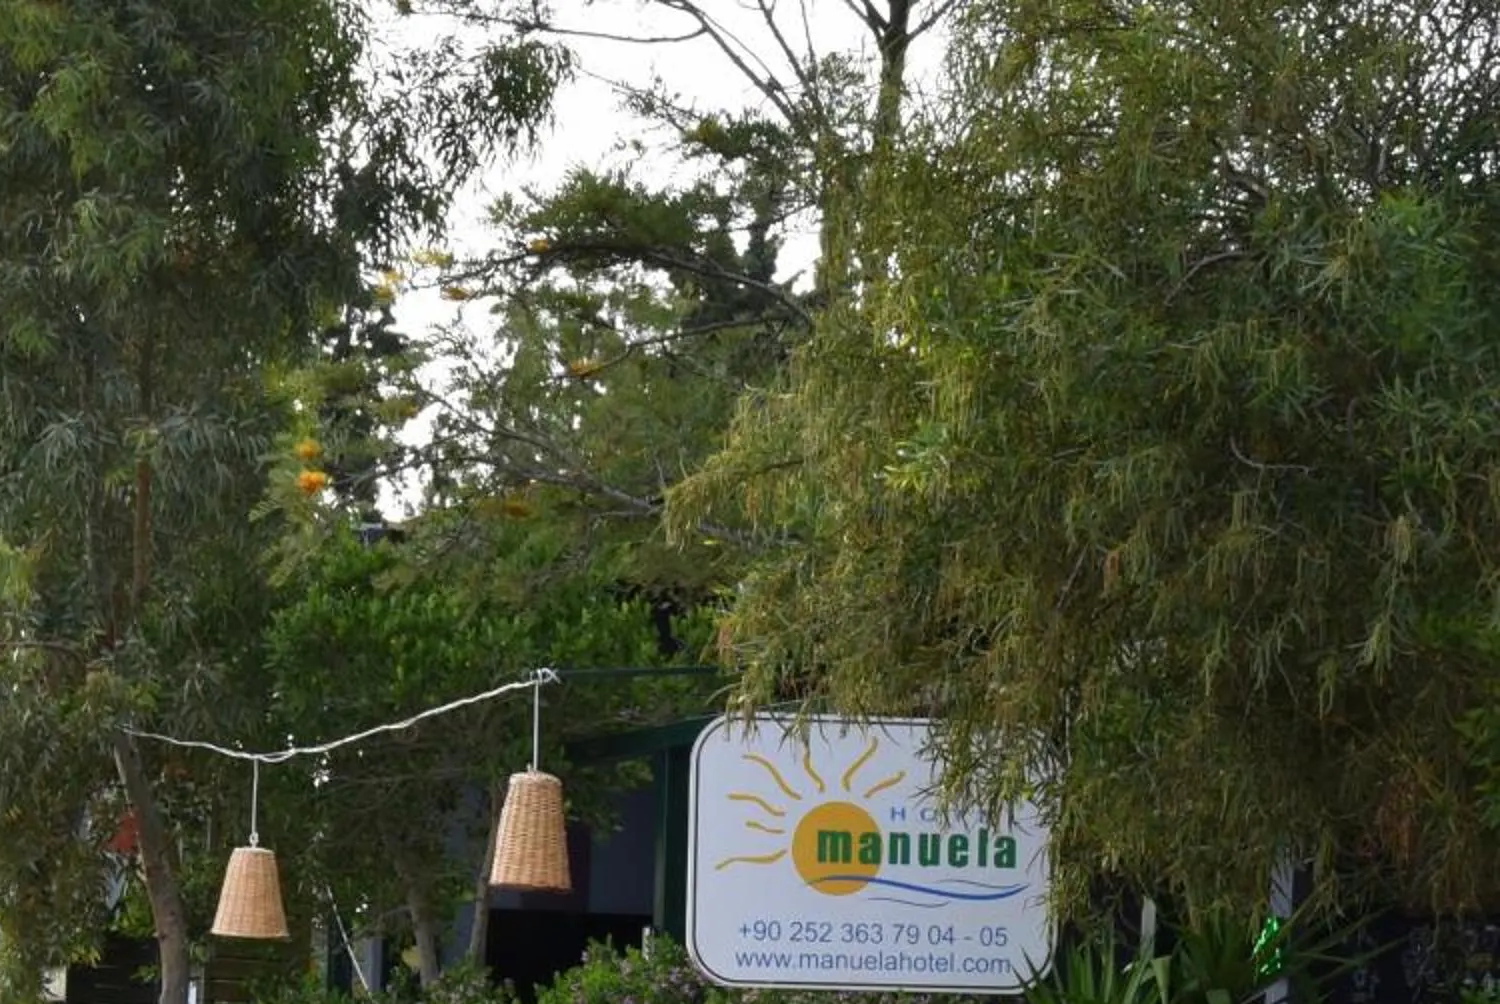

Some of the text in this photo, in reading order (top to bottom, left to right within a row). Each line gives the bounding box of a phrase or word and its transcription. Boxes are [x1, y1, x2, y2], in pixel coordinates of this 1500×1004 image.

[817, 827, 1017, 869] manuela
[739, 920, 781, 942] +90
[789, 921, 833, 943] 252
[840, 922, 883, 944] 363
[892, 923, 920, 945] 79
[927, 924, 955, 946] 04
[980, 926, 1008, 947] 05
[735, 951, 1011, 974] www.manuelahotel.com
